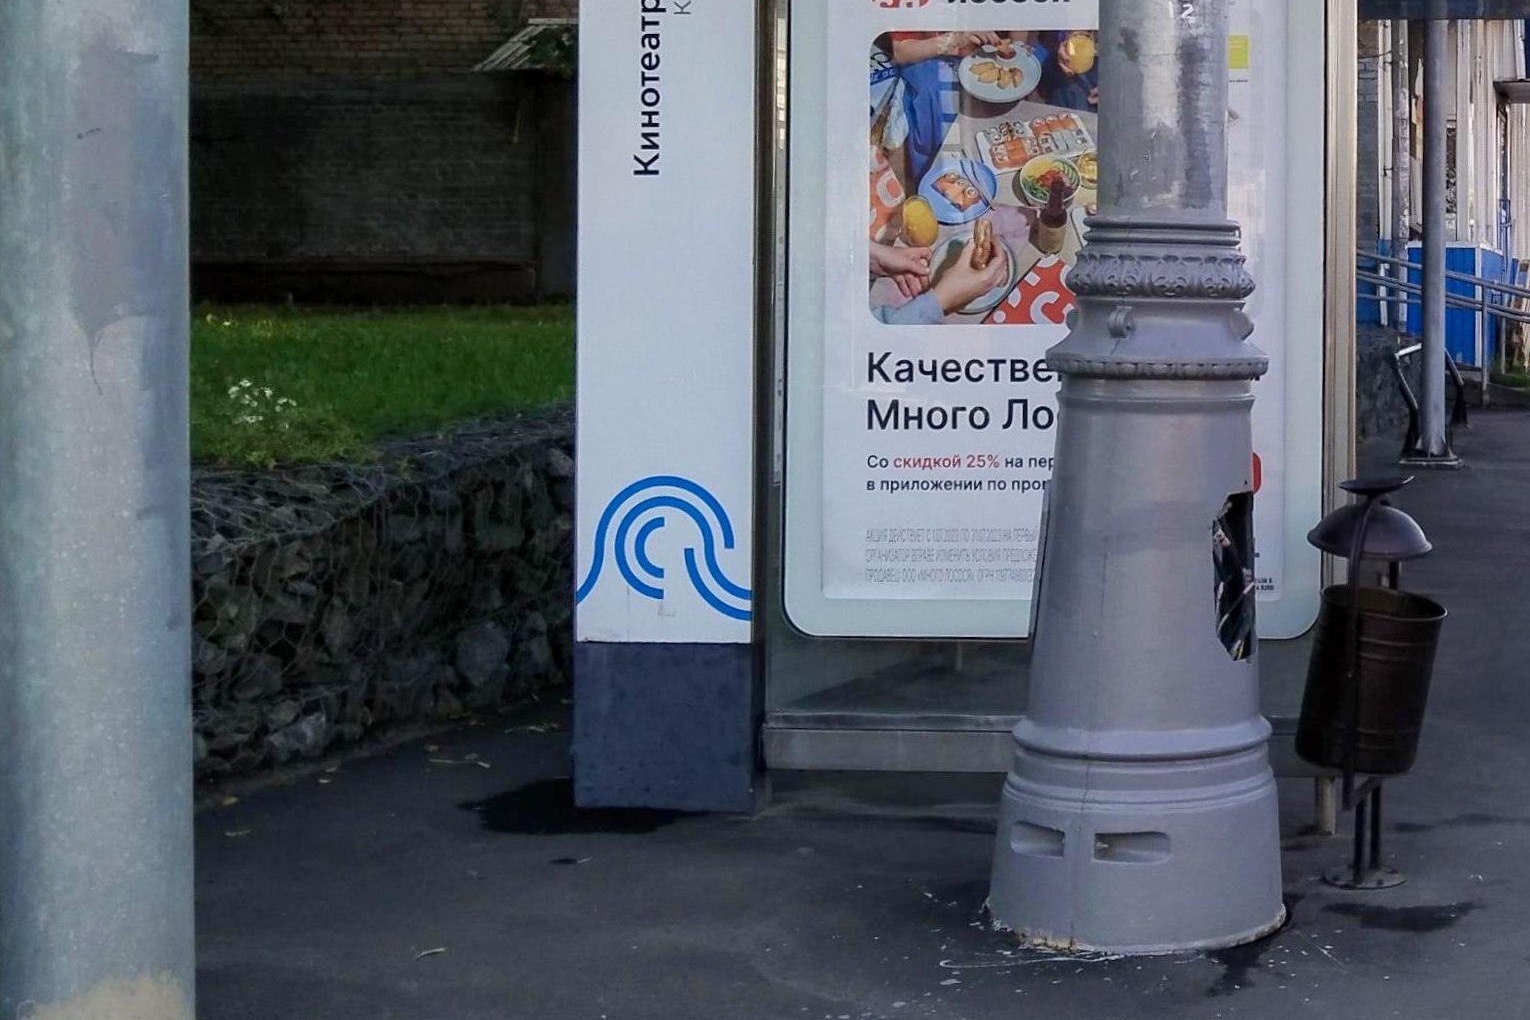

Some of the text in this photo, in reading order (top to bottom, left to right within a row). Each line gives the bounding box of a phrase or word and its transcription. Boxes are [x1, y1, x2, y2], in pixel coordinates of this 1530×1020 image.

[868, 352, 1062, 383] Качестве
[867, 399, 1061, 431] Много Ло
[867, 455, 889, 469] Со
[893, 454, 962, 471] скидкой
[966, 455, 1000, 469] 25%
[1004, 457, 1024, 469] на
[866, 480, 1047, 494] в приложении по про
